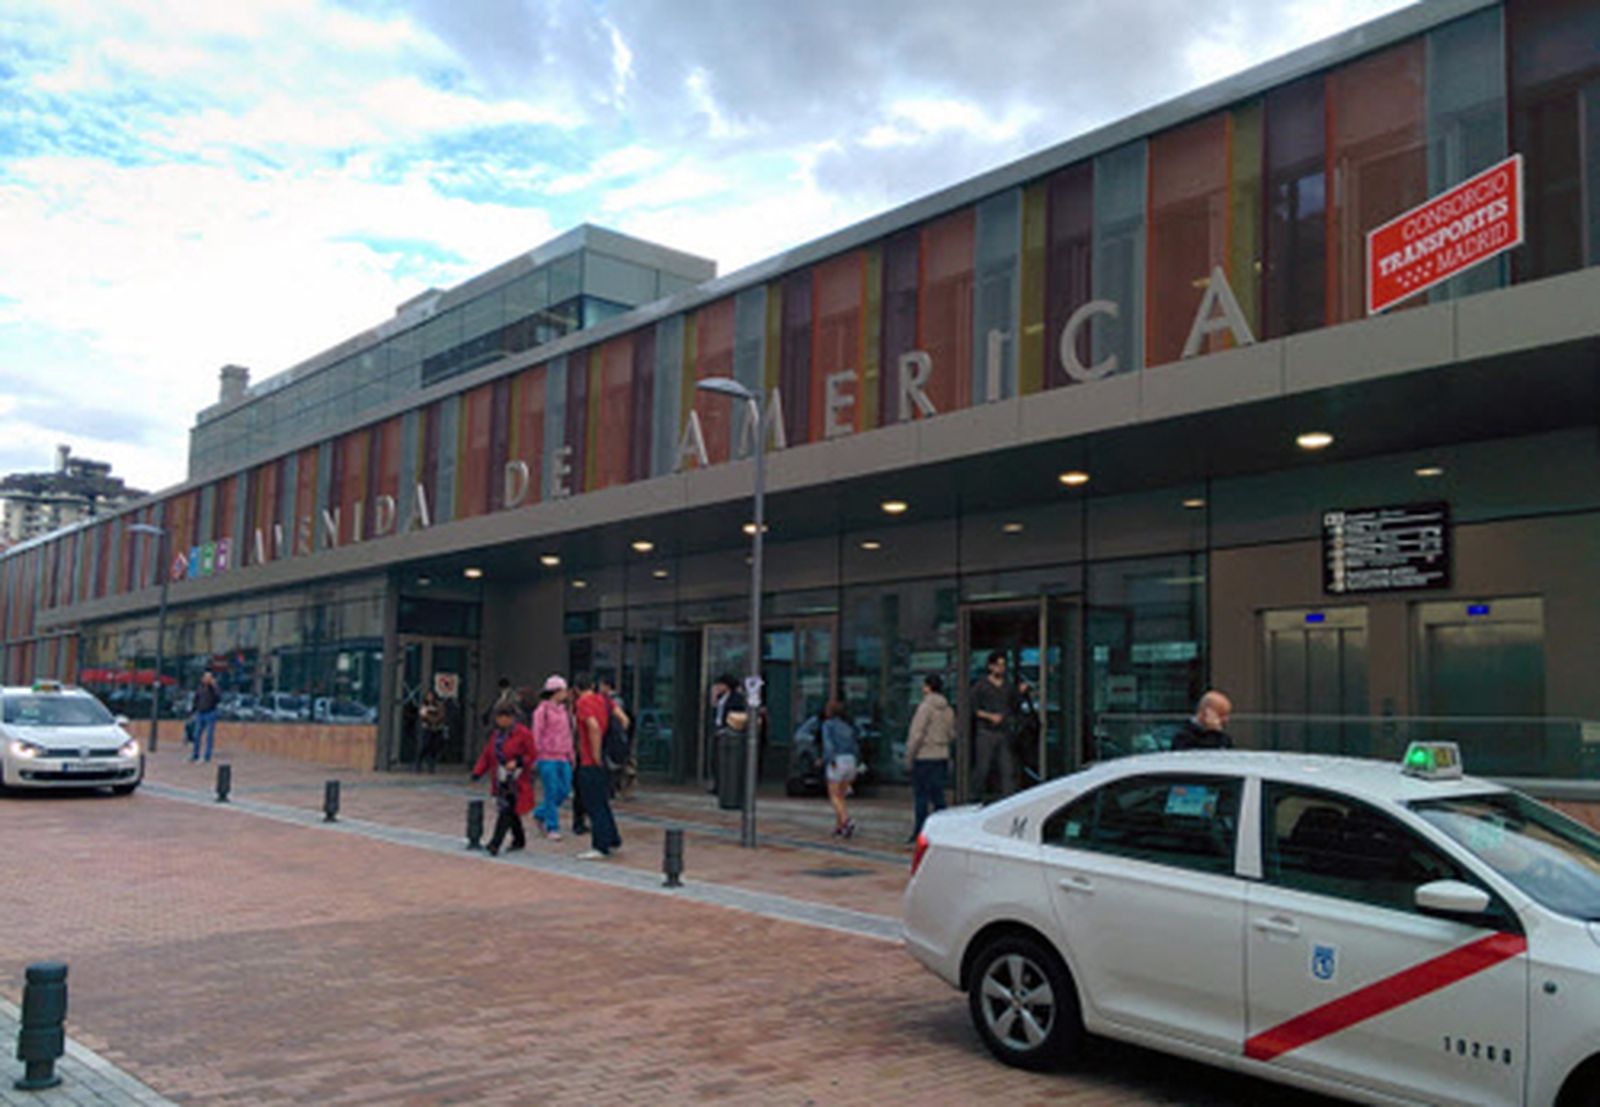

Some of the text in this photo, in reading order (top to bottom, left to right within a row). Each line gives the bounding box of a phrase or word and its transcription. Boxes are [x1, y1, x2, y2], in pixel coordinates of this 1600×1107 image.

[1378, 195, 1509, 277] TRANSPORTES
[1402, 170, 1509, 241] CONSORCIO
[1436, 220, 1509, 273] MADRID
[504, 446, 572, 508] DE
[674, 264, 1257, 472] AMERICA
